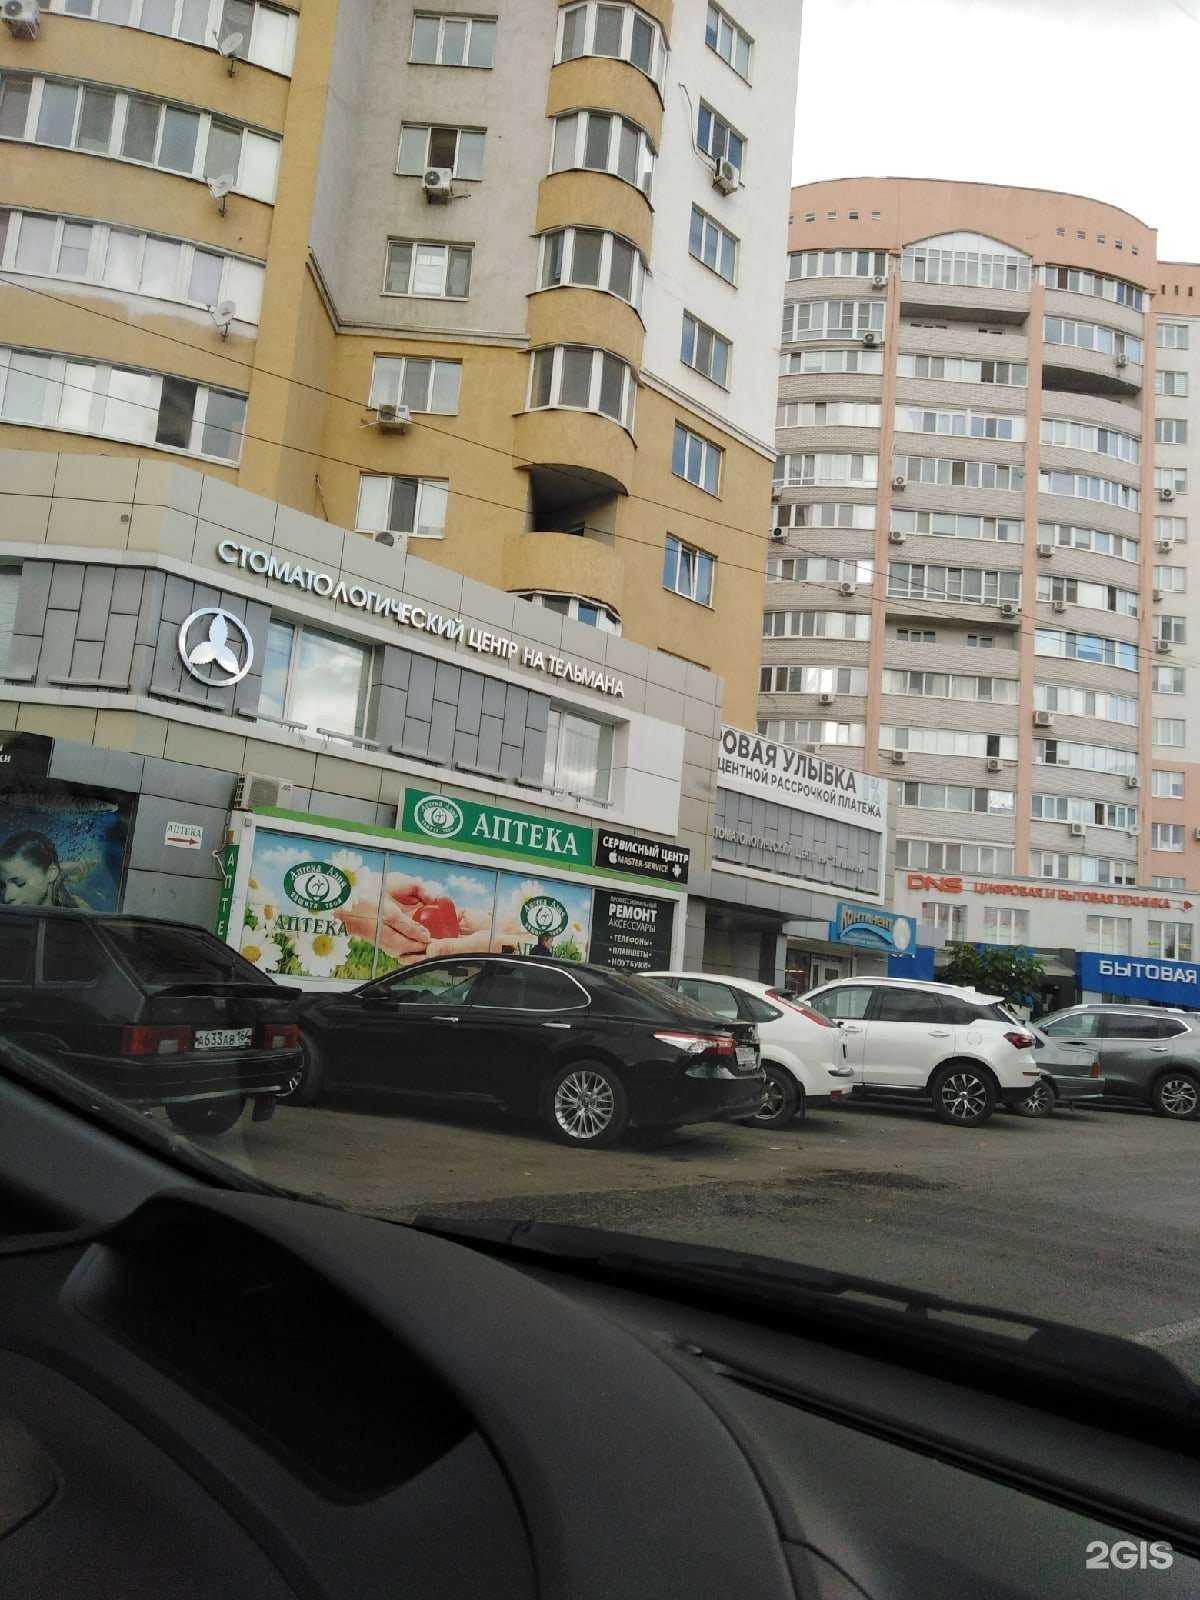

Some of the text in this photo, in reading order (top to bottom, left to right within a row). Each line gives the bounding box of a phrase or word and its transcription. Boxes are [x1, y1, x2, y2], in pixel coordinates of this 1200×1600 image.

[217, 539, 625, 698] СТОМАТОЛОГИЧЕСКИЙ ЦЕНТР НА ТЕЛЬМАНА
[719, 730, 857, 794] ОВАЯ УЛЫБКА
[771, 774, 836, 804] РАССРОЧКОЙ
[838, 795, 882, 819] ПЛАТЕЖА
[167, 824, 201, 838] АПТЕКА
[471, 812, 579, 856] АПТЕКА
[602, 835, 689, 864] СЕРВИСНЫЙ ЦЕНТР
[907, 874, 962, 893] DNS
[973, 881, 1042, 899] ЦИФРОВАЯ
[274, 914, 348, 937] АПТЕКА
[608, 903, 658, 923] РЕМОНТ
[608, 919, 656, 933] АКСЕССУАРЫ
[1099, 960, 1198, 985] БЫТОВАЯ
